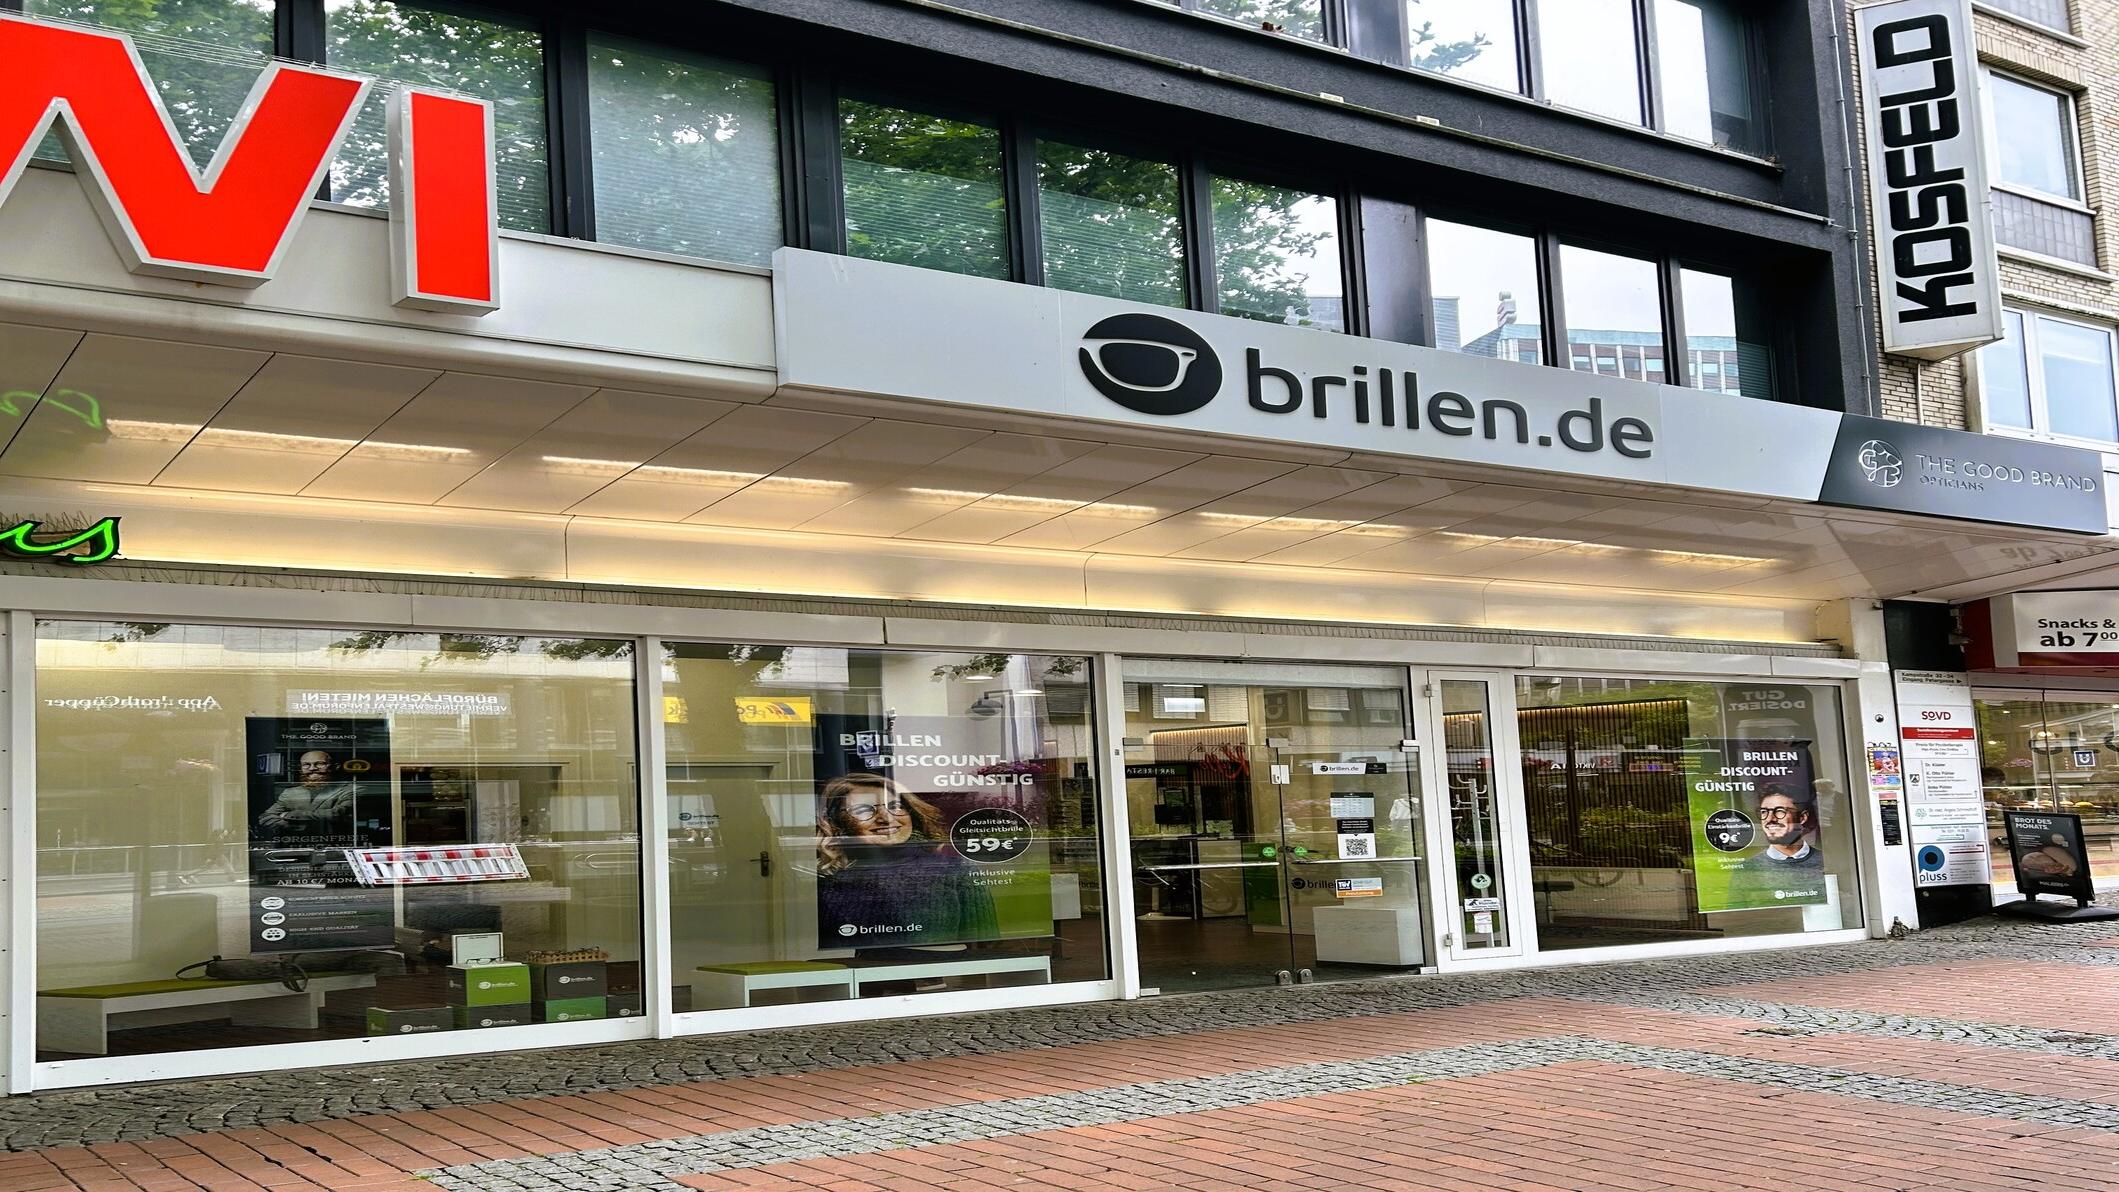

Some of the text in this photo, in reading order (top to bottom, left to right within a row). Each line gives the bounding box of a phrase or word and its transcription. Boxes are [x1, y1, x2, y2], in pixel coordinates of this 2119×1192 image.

[1872, 14, 1978, 324] KOSFELD
[1245, 346, 1654, 459] brillen.de
[1915, 454, 2097, 493] THE GOOD BRAND
[1919, 475, 1985, 492] OPTICIANS
[2038, 618, 2117, 630] Snacks &
[2040, 631, 2076, 647] ab
[840, 734, 942, 747] BRILLEN
[880, 754, 1008, 767] DISCOUNT-
[1742, 752, 1798, 761] BRILLEN
[1720, 766, 1794, 776] DISCOUNT-
[933, 772, 1034, 786] GÜNSTIG
[1694, 780, 1755, 792] GÜNSTIG
[968, 869, 1016, 877] inklusive
[973, 878, 1013, 886] Sehtest
[860, 922, 923, 934] brillen.de
